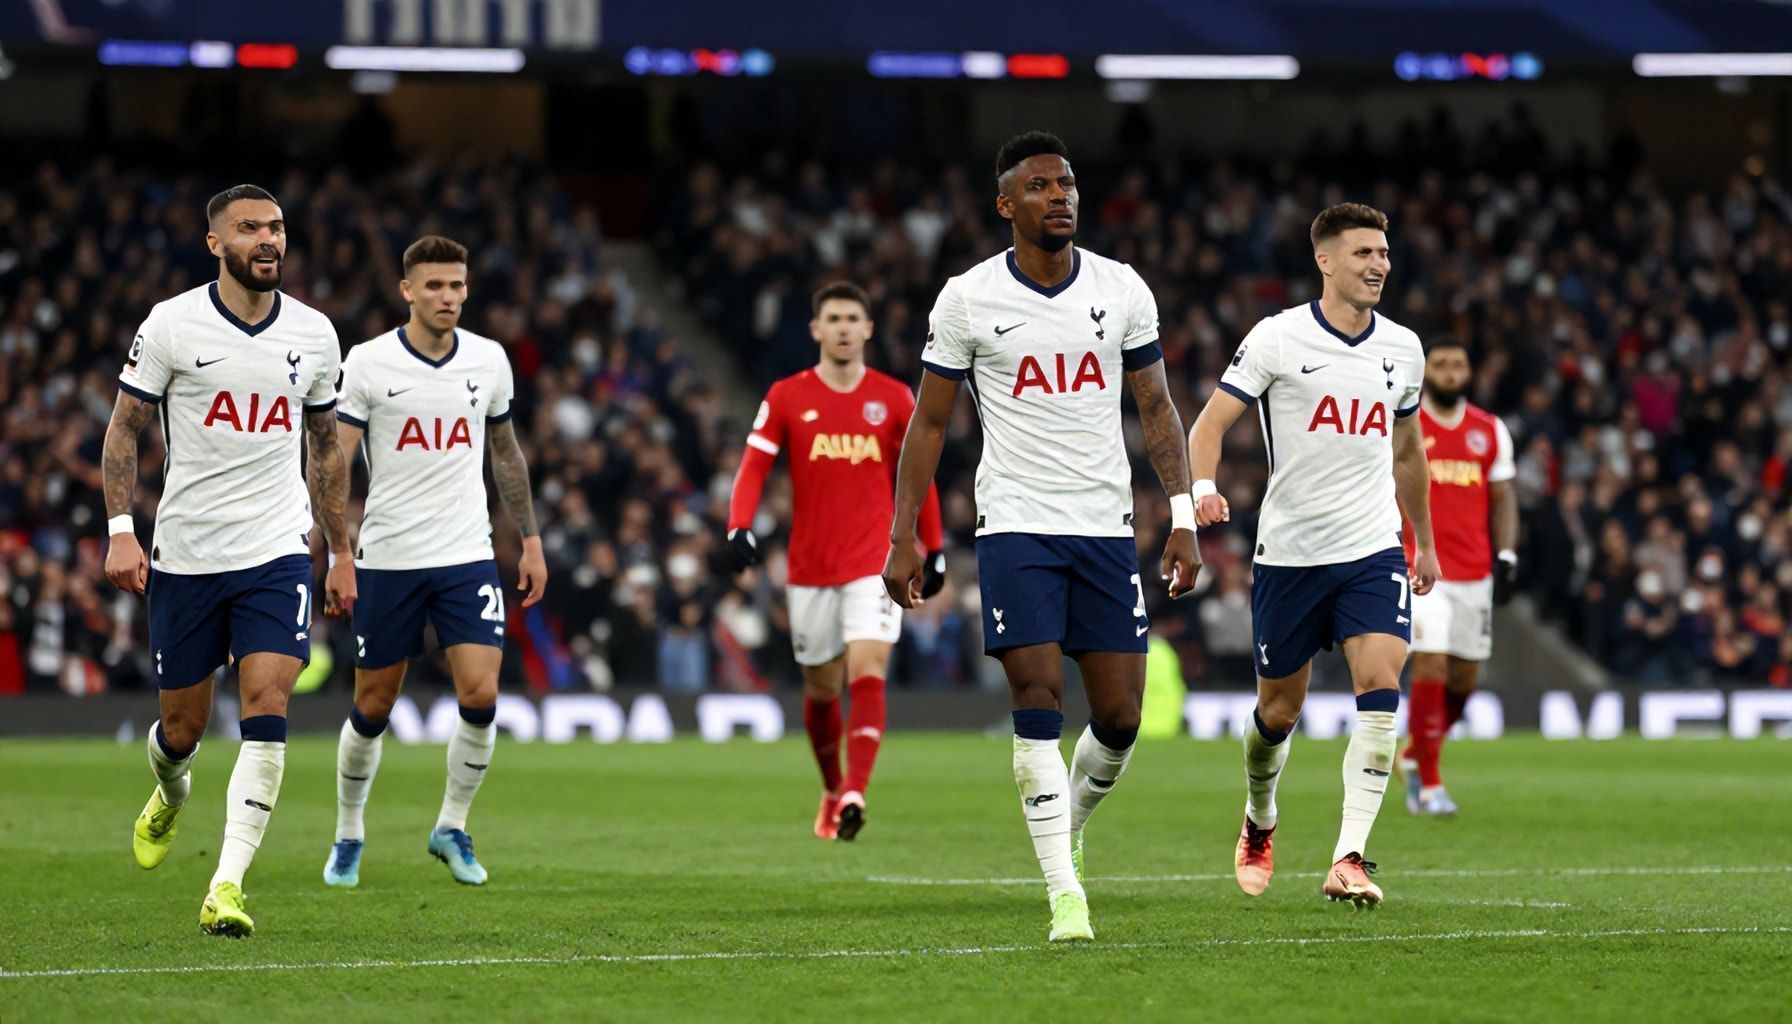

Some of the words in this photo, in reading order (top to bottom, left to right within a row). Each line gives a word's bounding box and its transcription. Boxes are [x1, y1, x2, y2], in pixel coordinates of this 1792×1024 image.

[1013, 351, 1106, 398] AIA
[204, 391, 292, 432] AIA
[1307, 395, 1388, 437] AIA
[395, 416, 472, 451] AIA
[477, 584, 505, 621] 21
